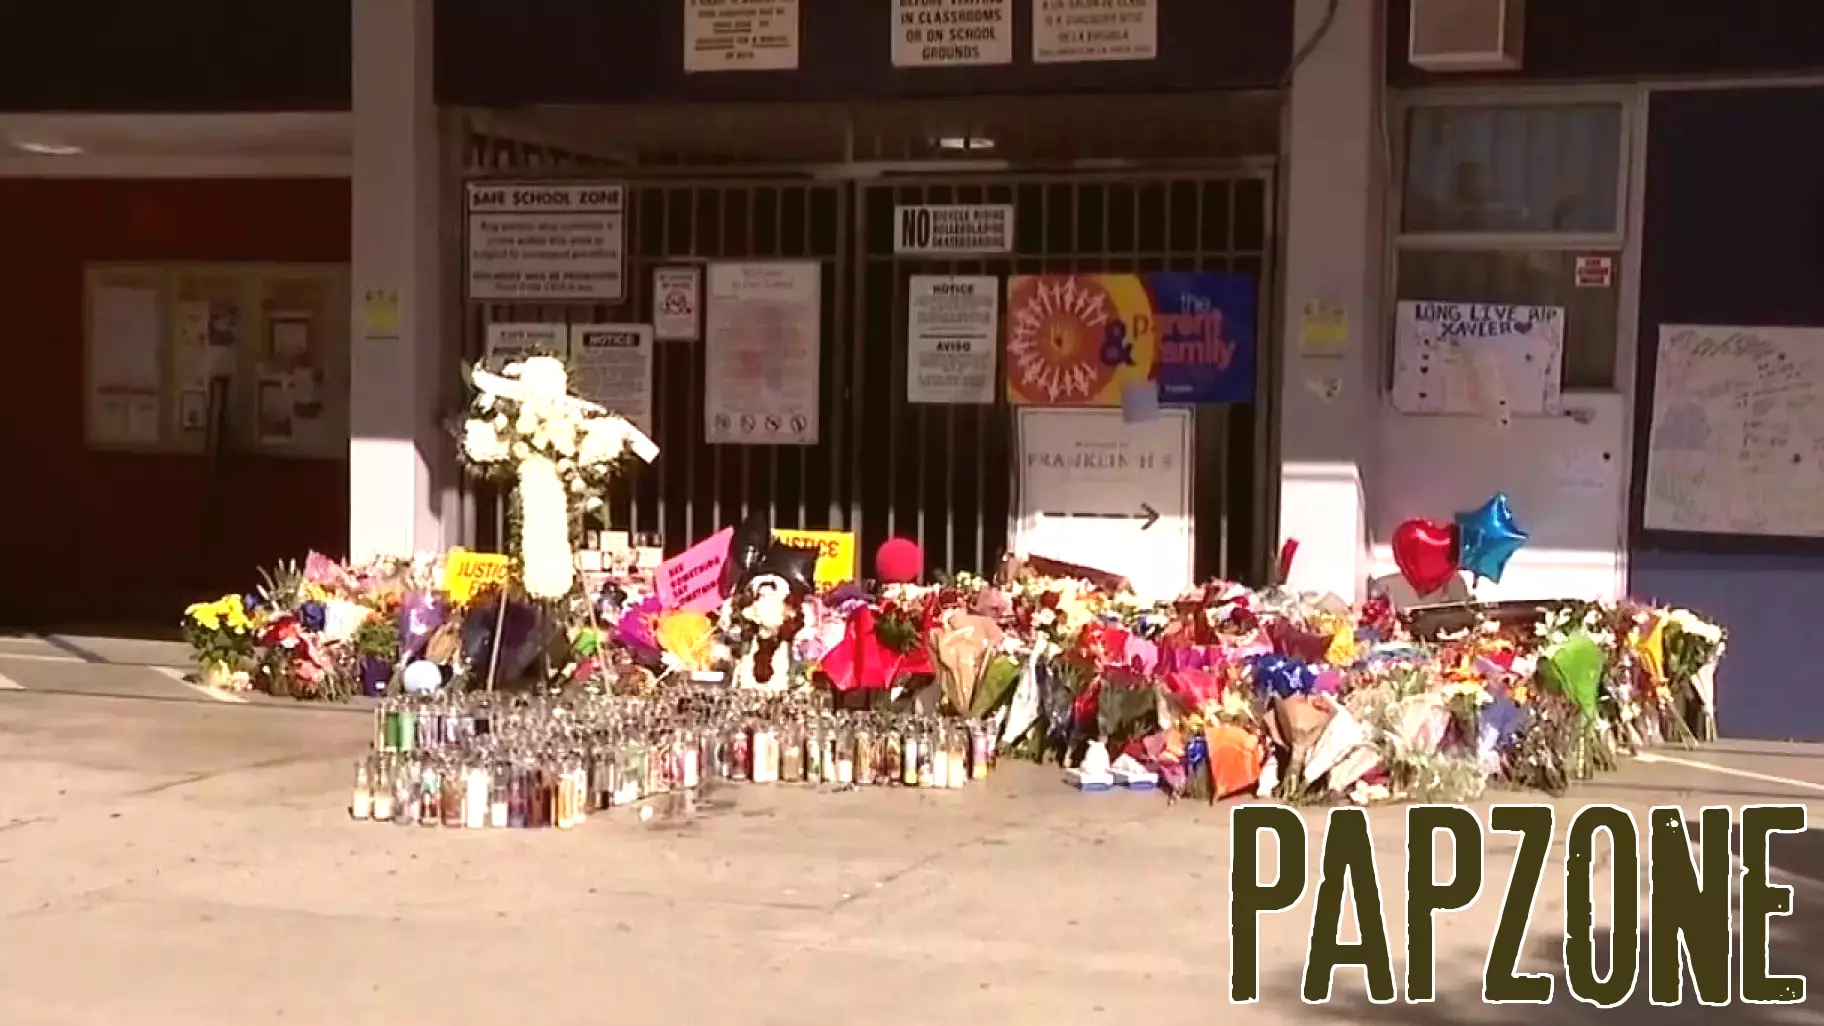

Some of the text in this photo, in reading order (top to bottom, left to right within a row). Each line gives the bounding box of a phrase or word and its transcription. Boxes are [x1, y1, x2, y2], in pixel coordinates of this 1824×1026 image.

[901, 10, 1002, 24] IN CLASSROOMS
[927, 29, 942, 41] ON
[949, 27, 996, 40] SCHOOL
[922, 45, 980, 60] GROUNDS
[473, 189, 620, 205] SAFE SCHOOL ZONE
[902, 209, 931, 248] NO
[933, 283, 973, 295] NOTICE
[1181, 292, 1212, 313] the
[1415, 303, 1557, 323] LONG LIVE RIP
[1133, 309, 1223, 339] parent
[1438, 321, 1512, 340] XAVIER
[589, 334, 634, 347] NOTICE
[936, 341, 971, 352] AVISO
[1156, 333, 1236, 370] family
[1028, 453, 1128, 469] FRANKLIN
[457, 560, 506, 579] JUSTIC
[671, 554, 720, 588] SOMETHING
